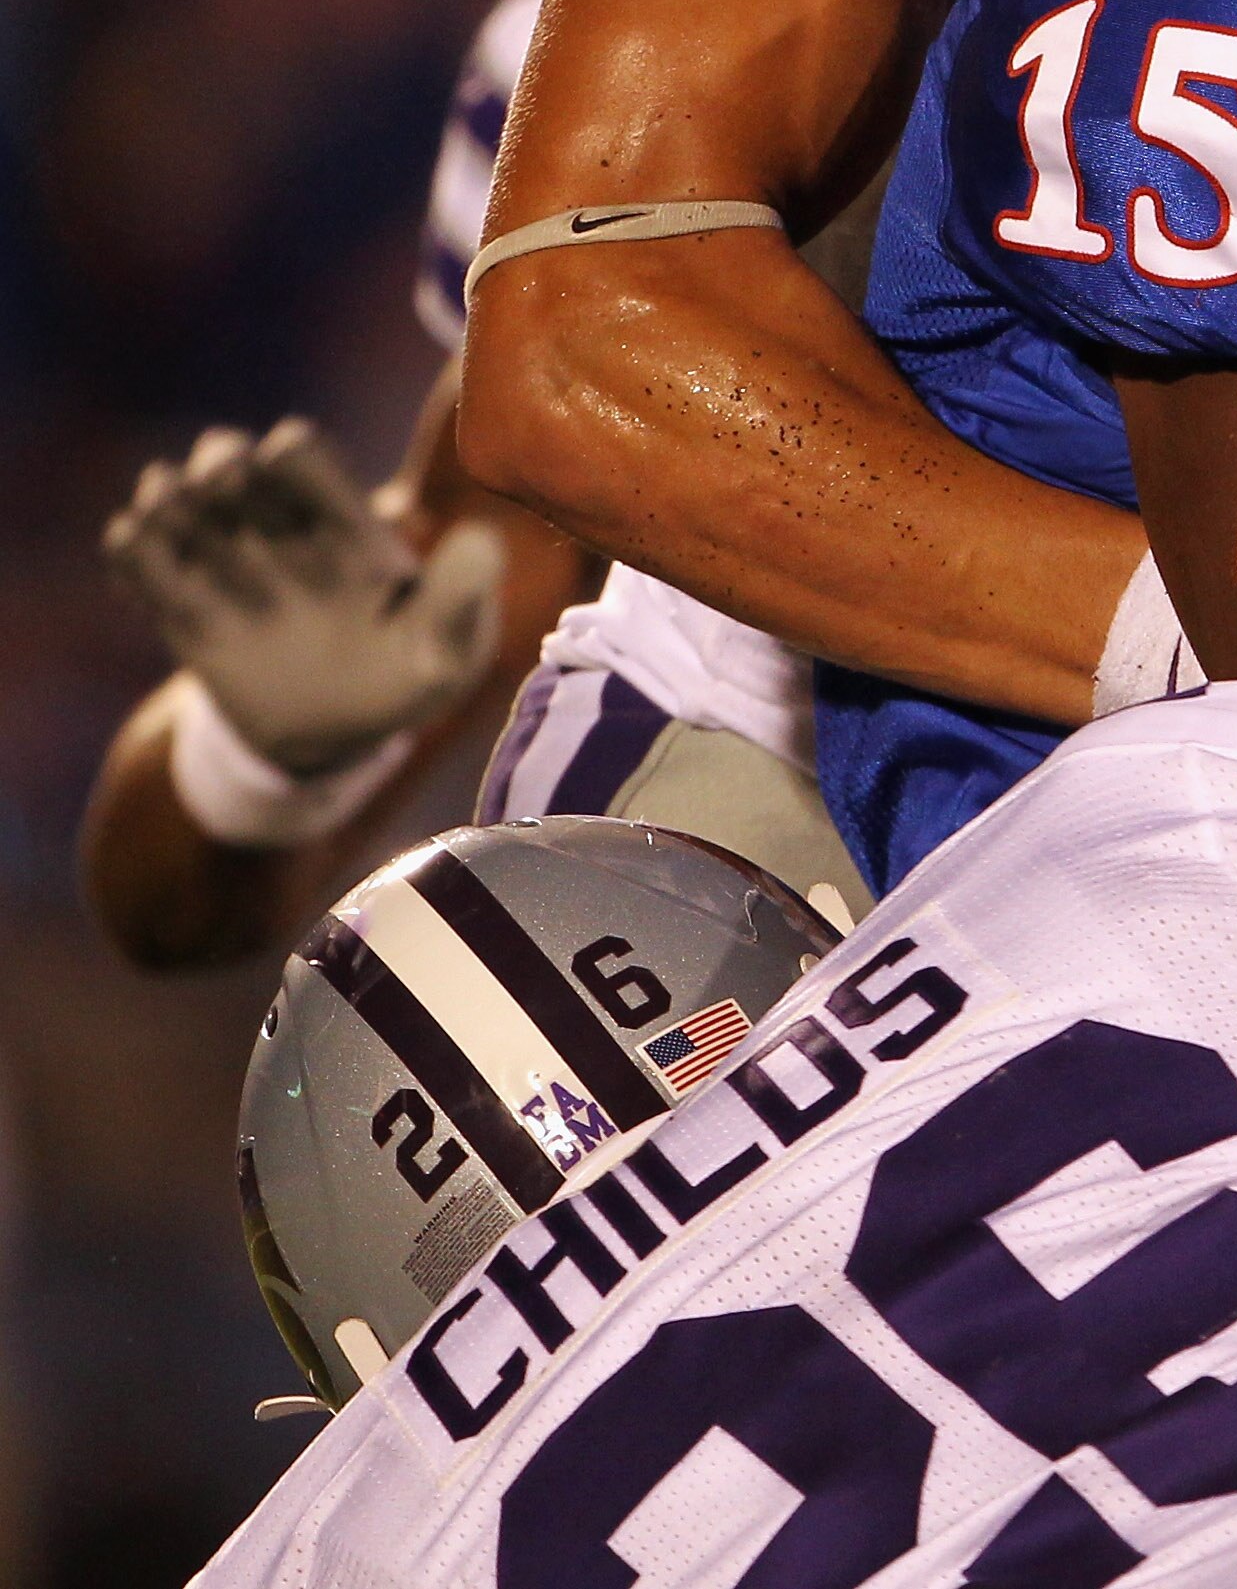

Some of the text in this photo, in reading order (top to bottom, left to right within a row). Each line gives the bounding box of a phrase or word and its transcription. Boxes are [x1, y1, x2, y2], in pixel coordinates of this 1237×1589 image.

[371, 934, 672, 1203] 2 6
[406, 936, 969, 1443] CHILDS
[412, 1193, 458, 1245] WARNING
